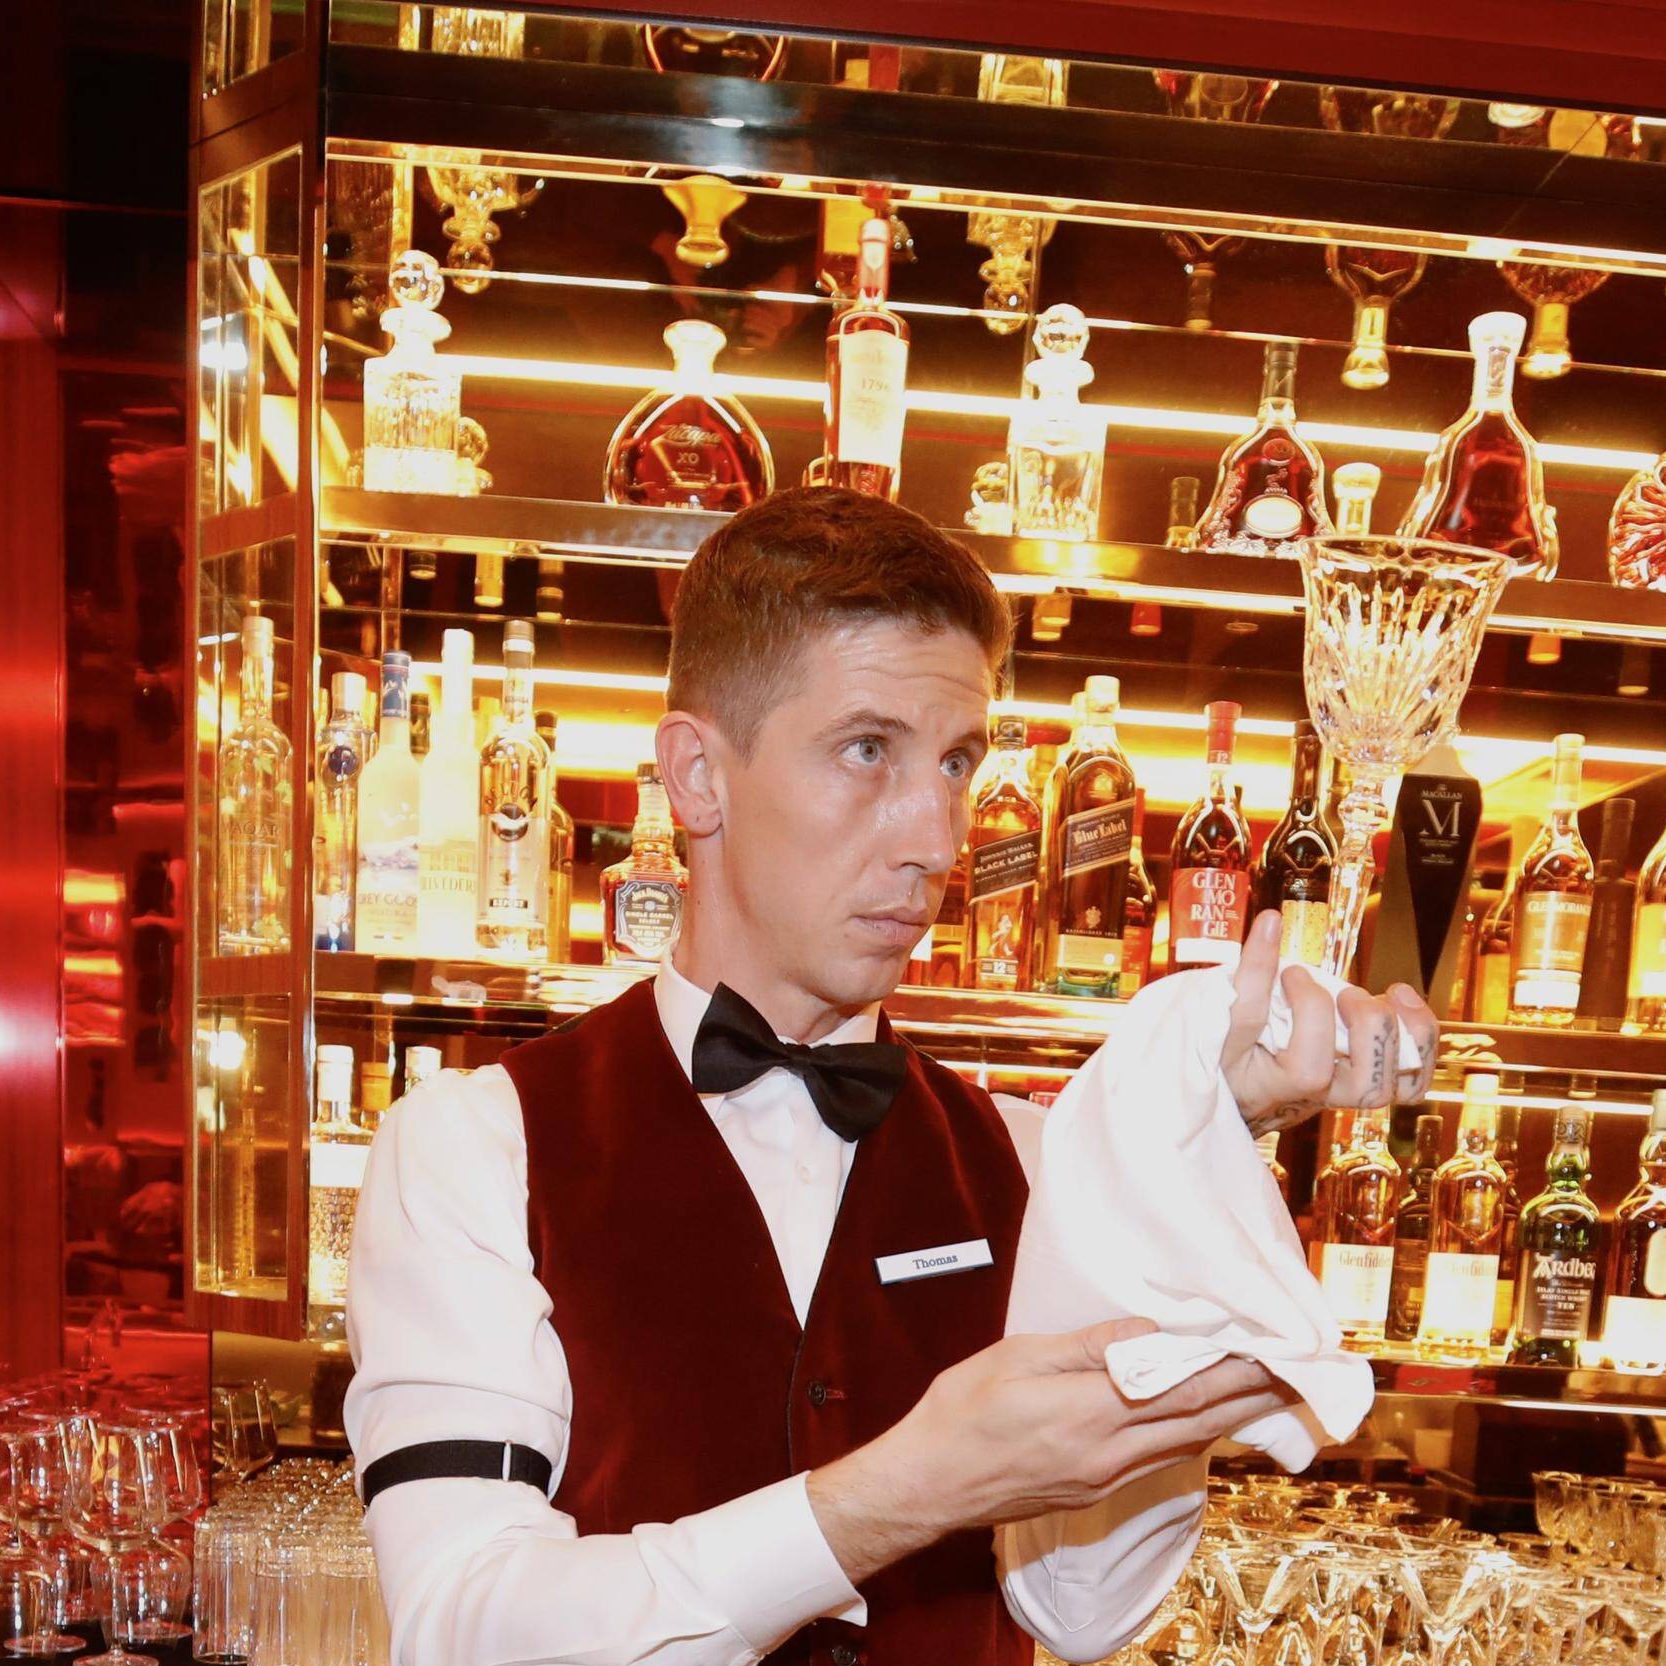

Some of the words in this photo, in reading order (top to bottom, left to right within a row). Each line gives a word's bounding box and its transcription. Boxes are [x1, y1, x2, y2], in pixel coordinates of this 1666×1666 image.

[676, 453, 700, 464] XO
[1421, 790, 1463, 799] MACALLAN
[1098, 819, 1127, 839] Label
[974, 859, 1006, 875] BLACK
[1007, 851, 1038, 865] LABEL
[1192, 871, 1236, 889] GLEN
[1190, 904, 1225, 921] RAN
[1202, 920, 1229, 938] GIE
[912, 1255, 958, 1270] Thomas
[1557, 1302, 1576, 1310] TEN
